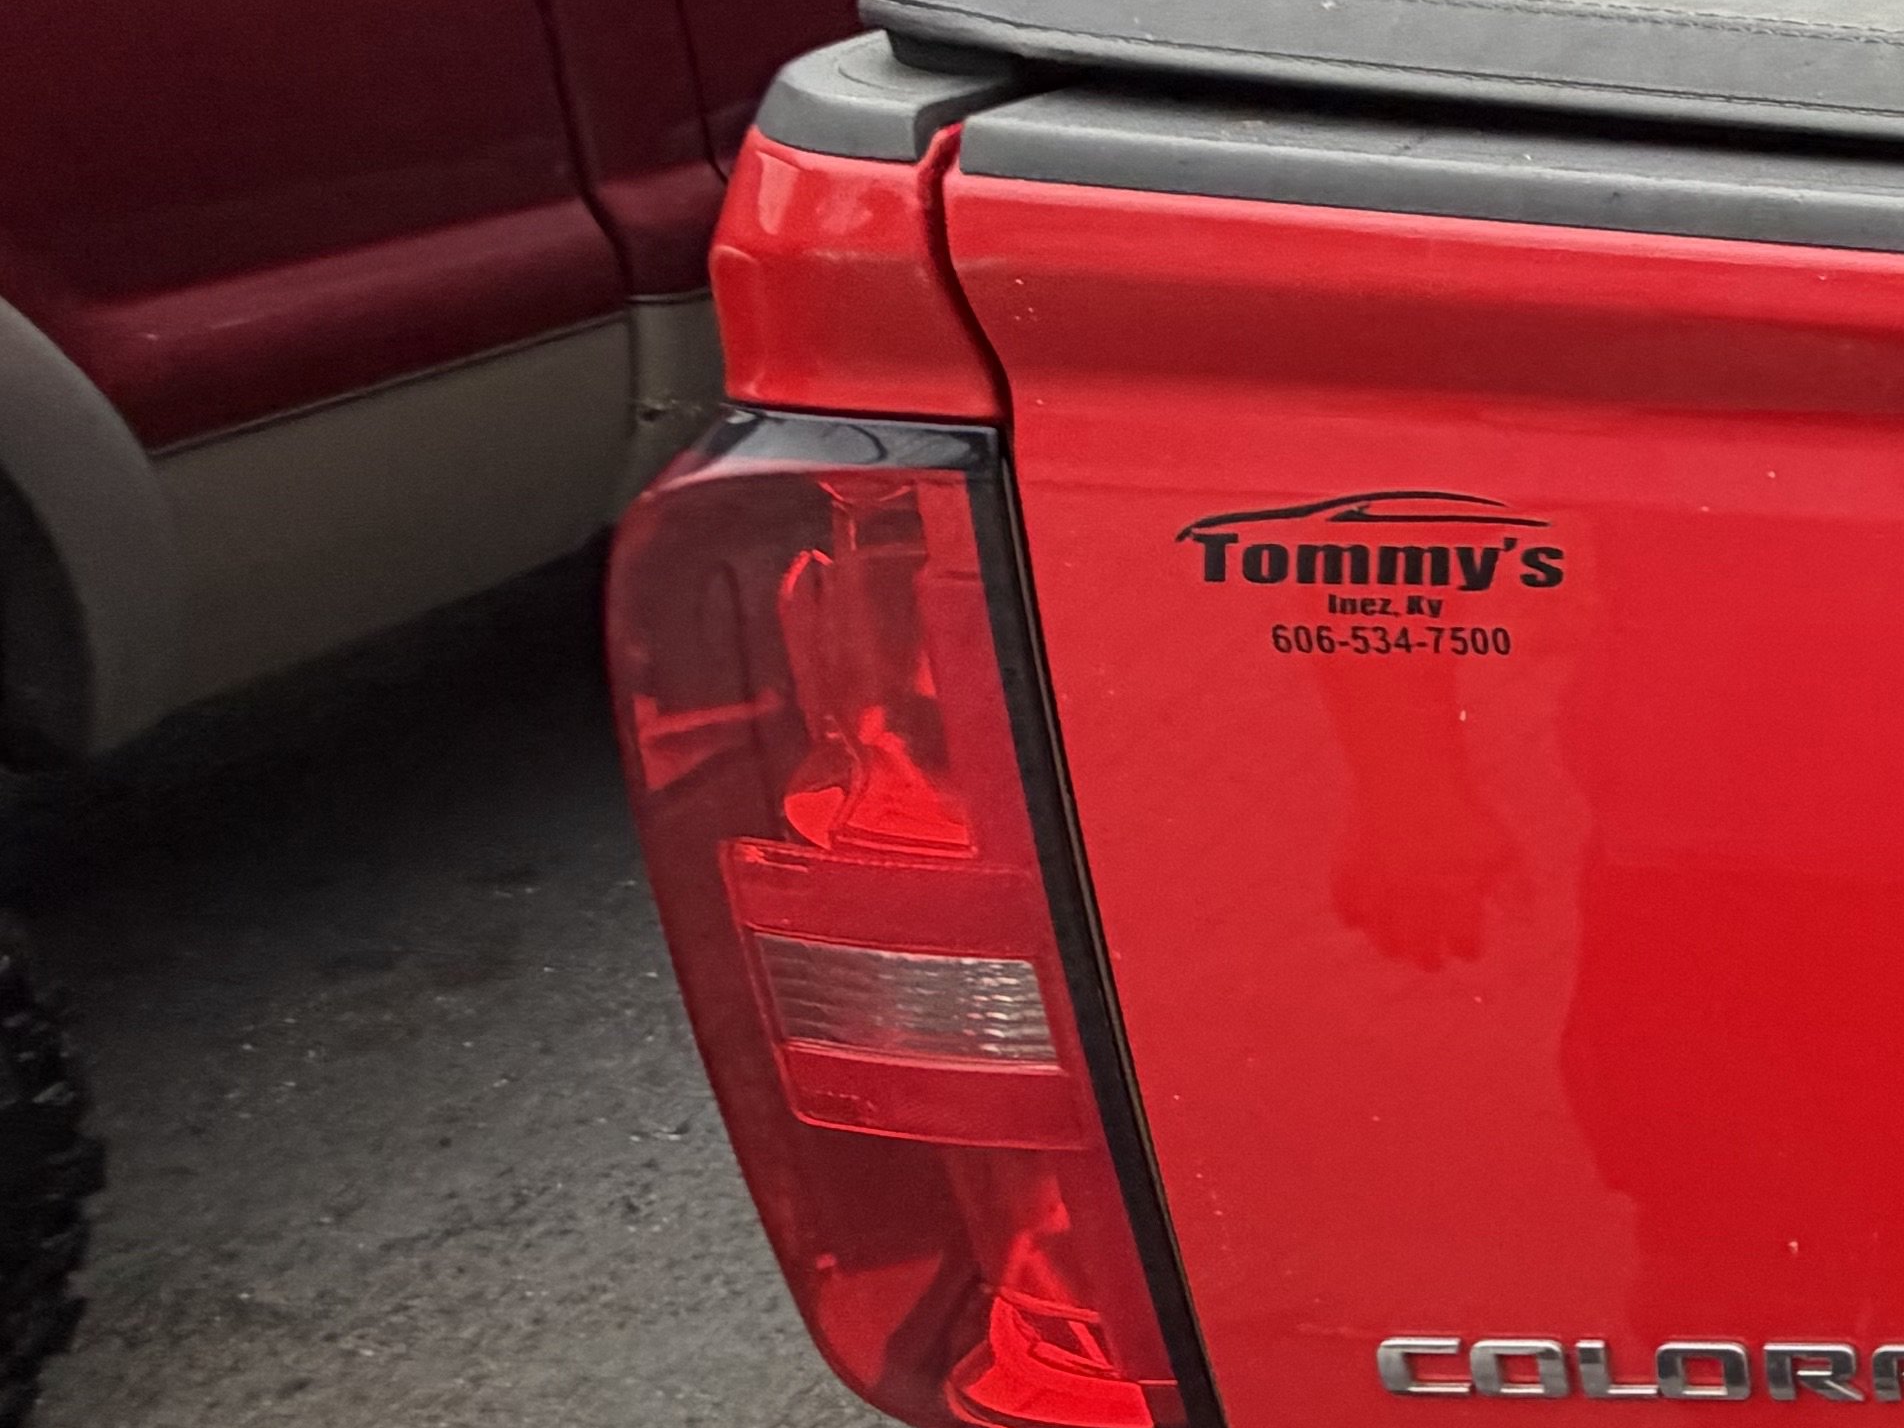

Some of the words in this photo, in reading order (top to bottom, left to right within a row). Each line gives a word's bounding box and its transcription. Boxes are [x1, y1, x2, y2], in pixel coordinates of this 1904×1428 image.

[1193, 532, 1565, 591] Tommy's
[1406, 594, 1444, 618] Ky
[1271, 624, 1512, 656] 606-534-7500
